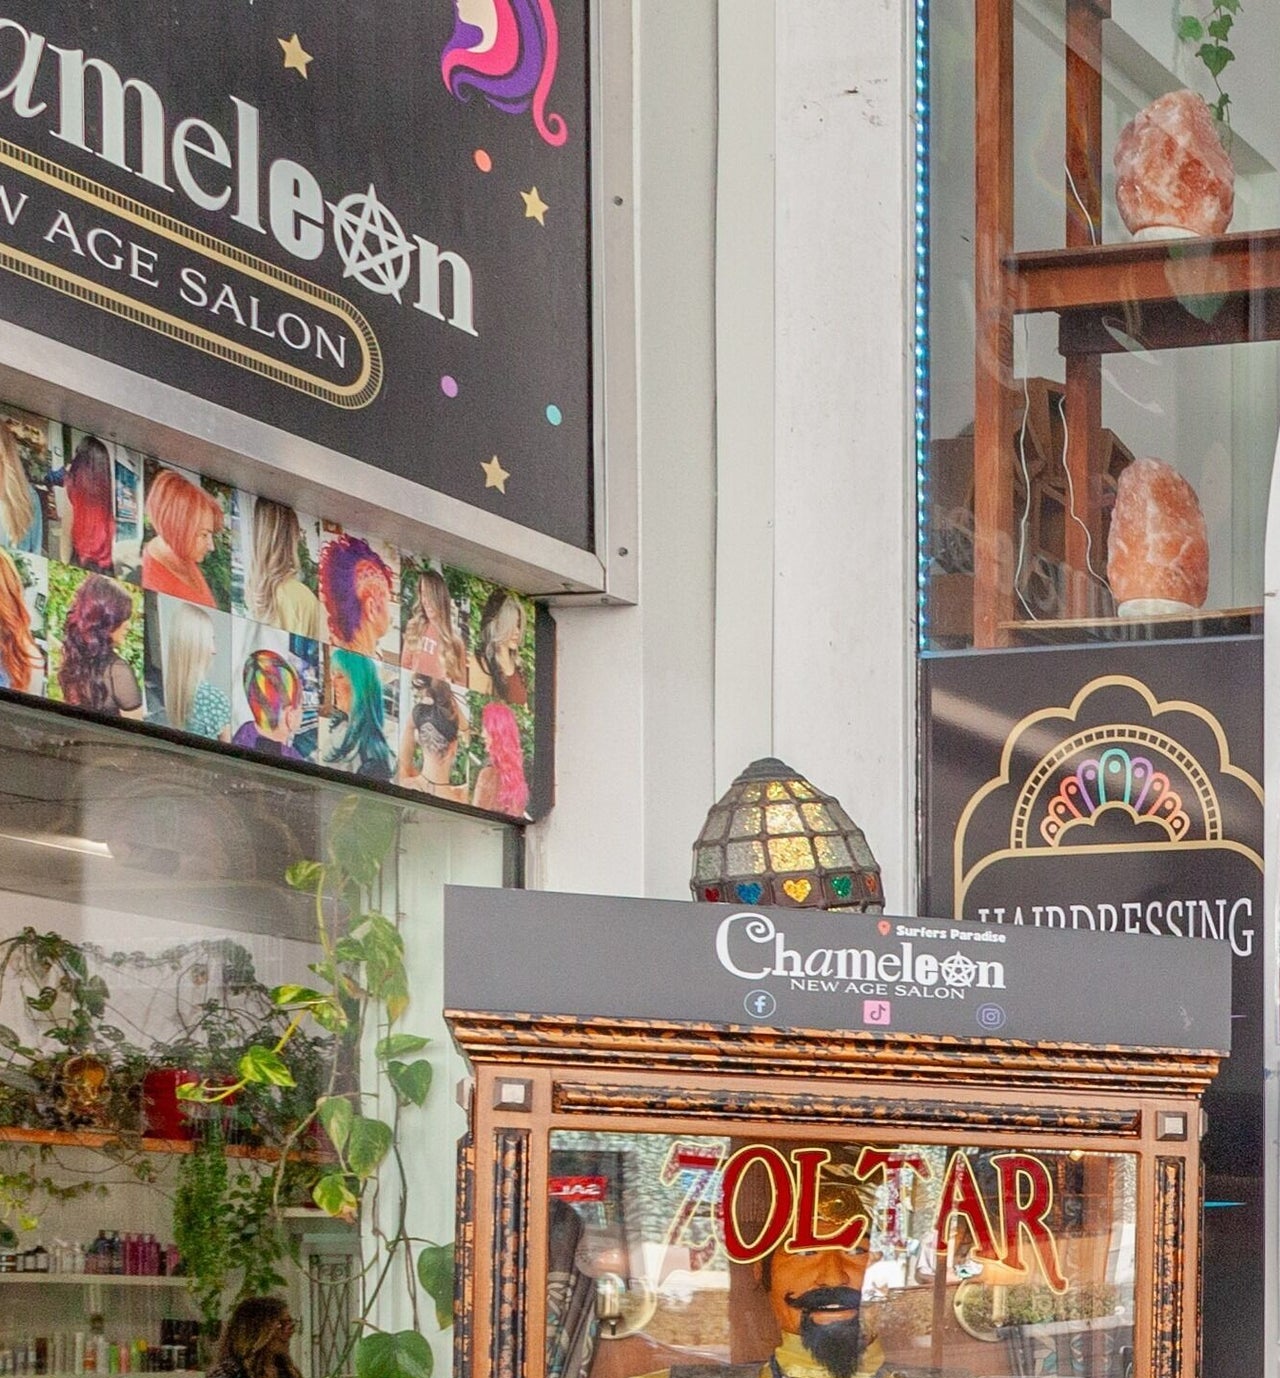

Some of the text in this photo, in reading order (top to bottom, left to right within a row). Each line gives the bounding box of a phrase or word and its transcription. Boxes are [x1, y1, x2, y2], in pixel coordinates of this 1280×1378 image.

[46, 210, 348, 369] AGE SALON
[716, 912, 1006, 989] Chameleon
[896, 924, 1006, 944] Surfers Paradise
[979, 898, 1254, 956] ESSING
[790, 978, 965, 1000] NEW AGE SALON
[658, 1142, 1069, 1295] ZOLTAR
